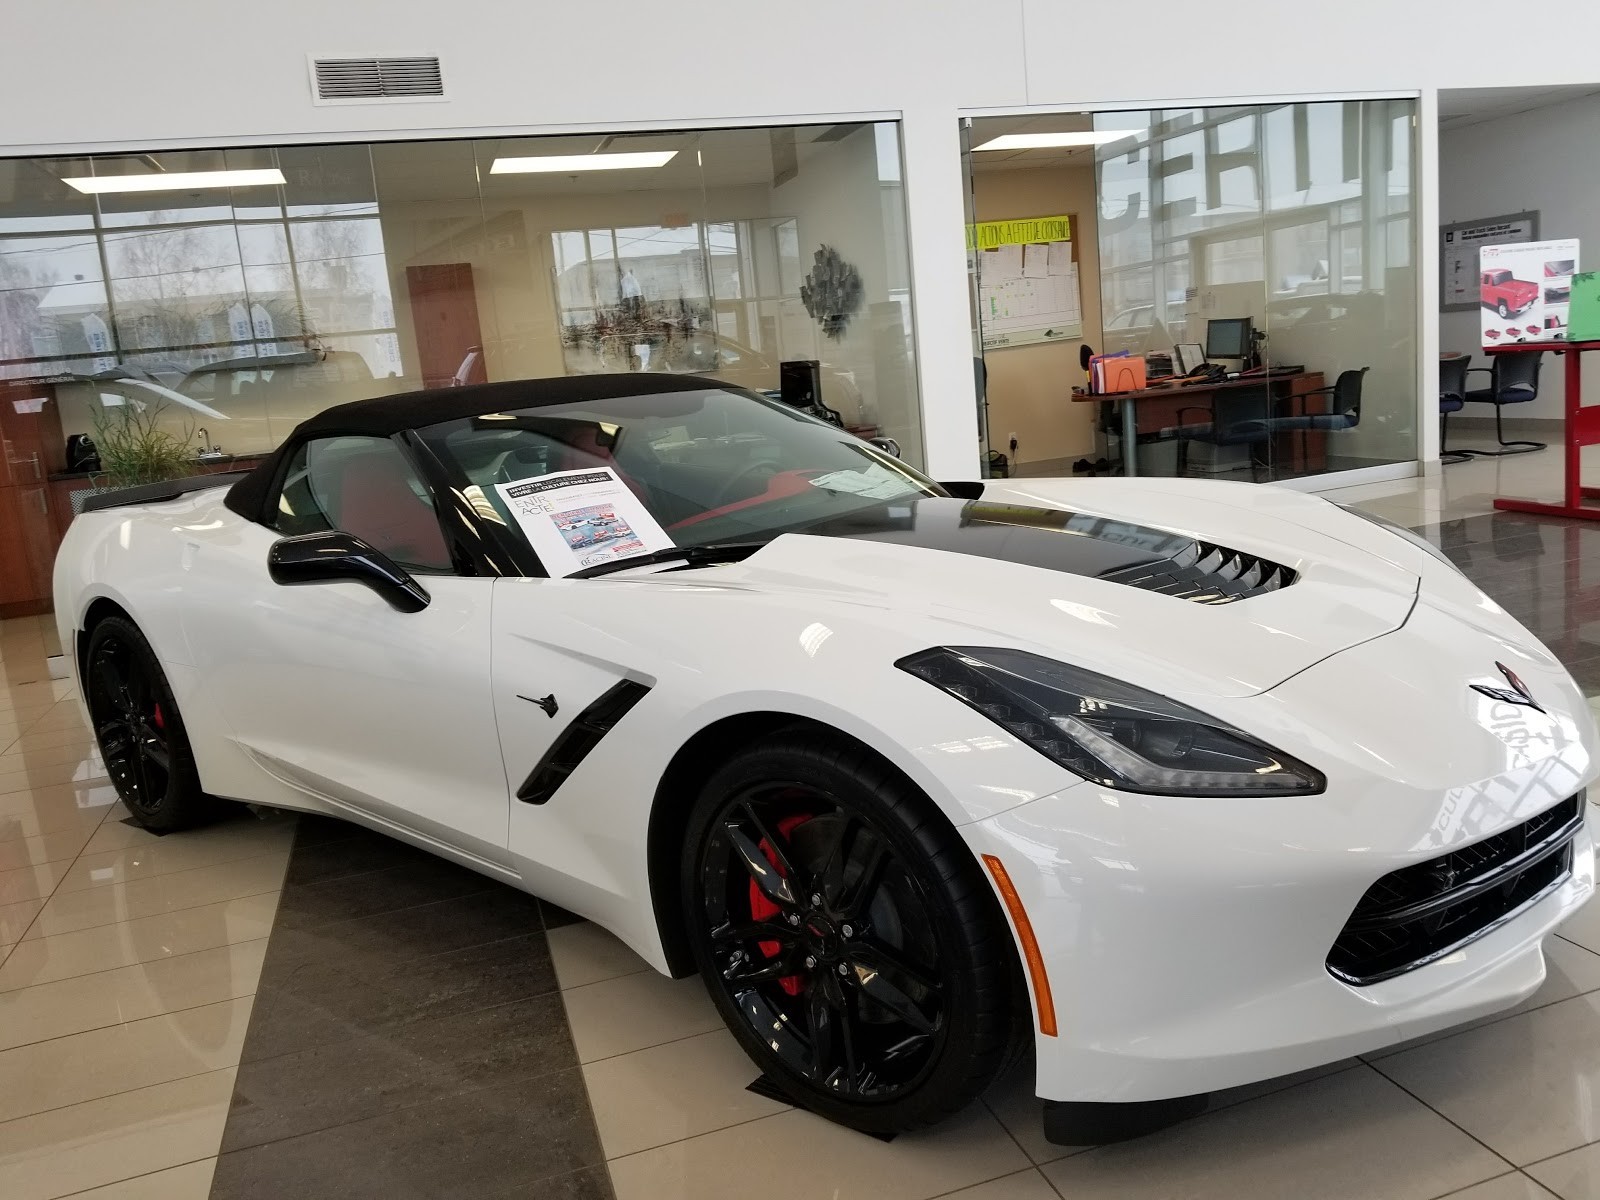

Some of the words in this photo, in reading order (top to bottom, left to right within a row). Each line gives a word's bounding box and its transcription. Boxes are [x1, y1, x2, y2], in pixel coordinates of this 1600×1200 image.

[509, 482, 542, 493] INVESTIR
[511, 489, 533, 497] VIVRE
[541, 481, 571, 490] CULTURE
